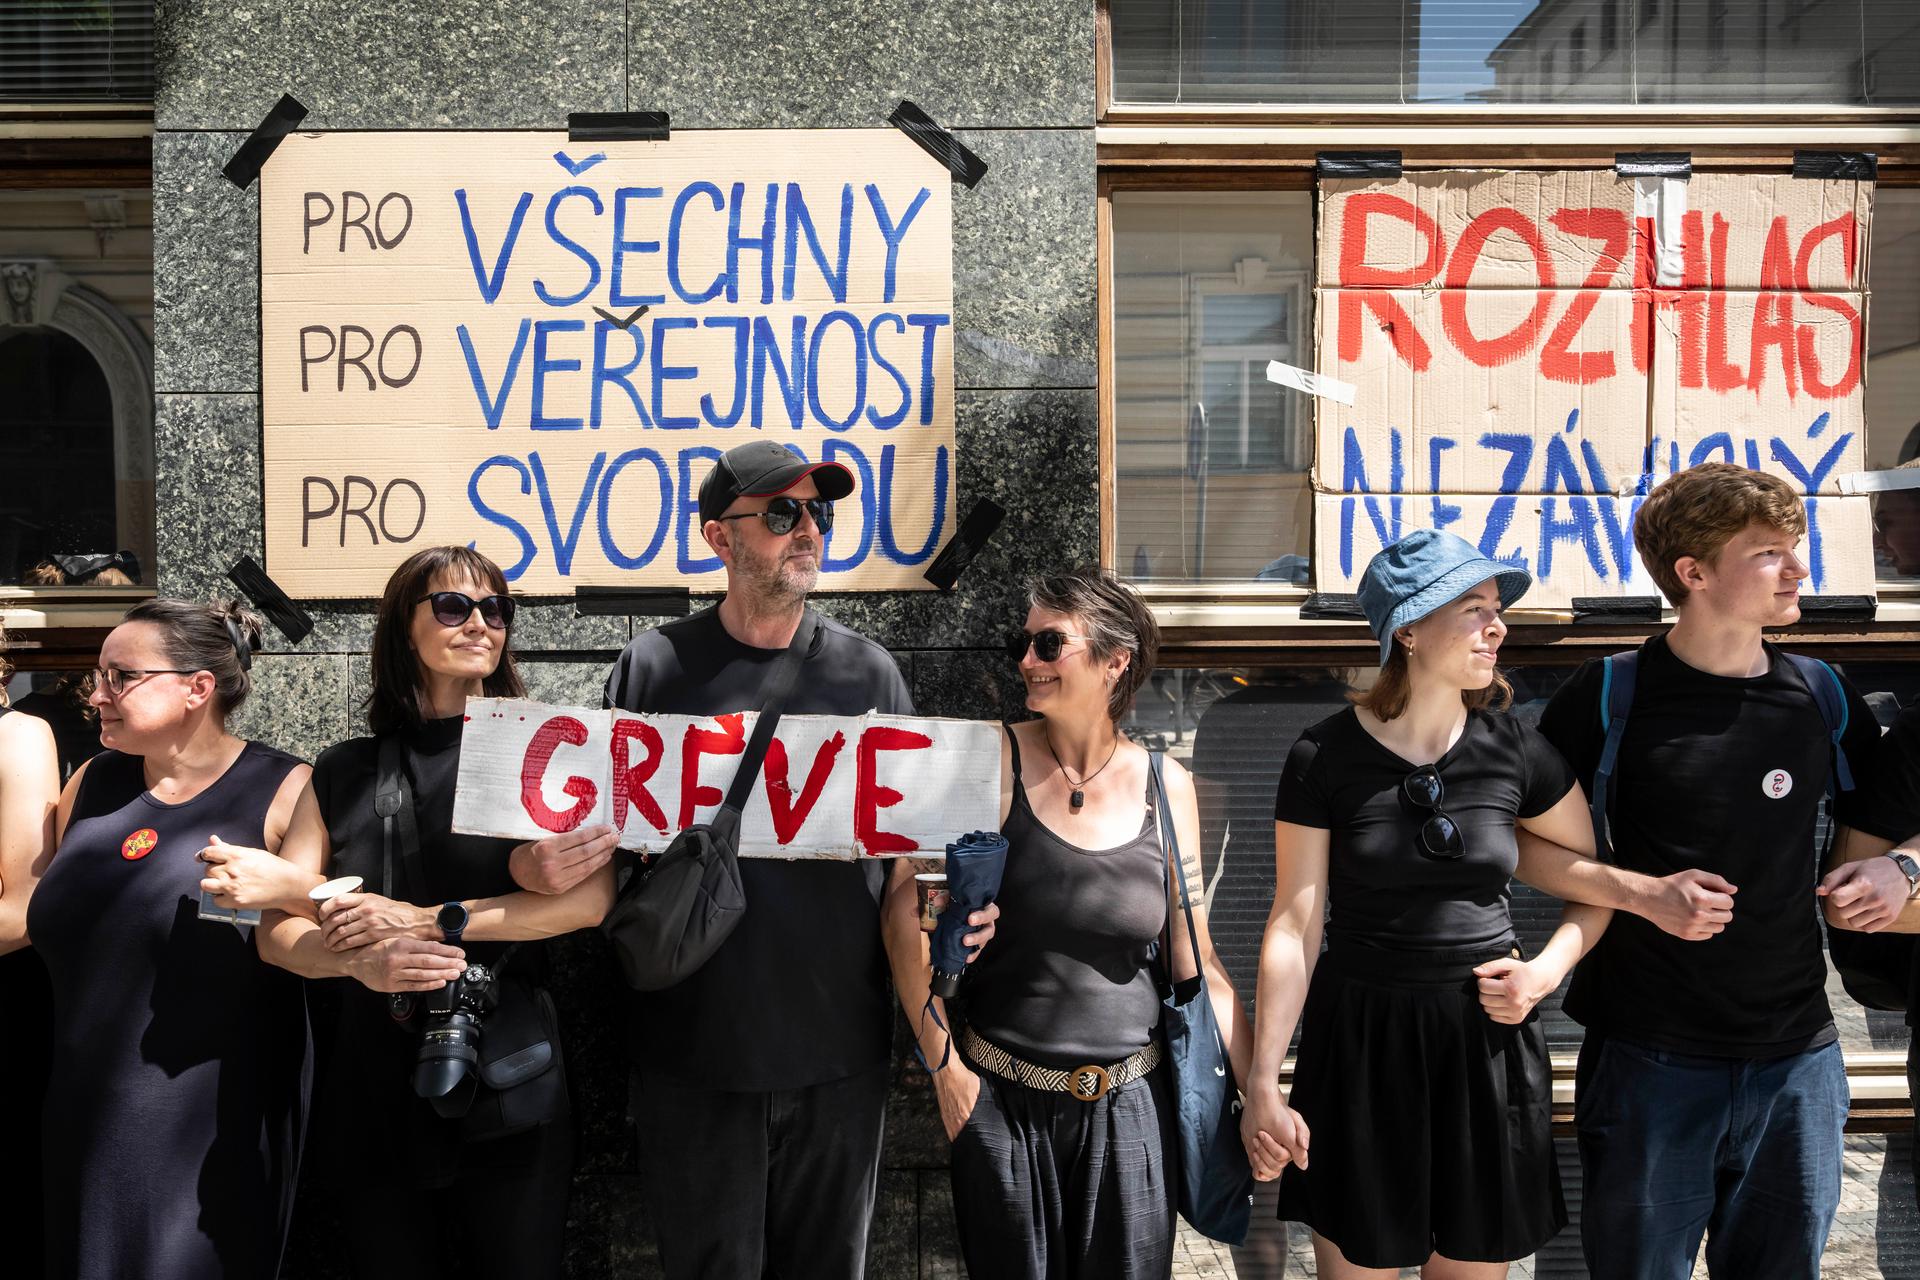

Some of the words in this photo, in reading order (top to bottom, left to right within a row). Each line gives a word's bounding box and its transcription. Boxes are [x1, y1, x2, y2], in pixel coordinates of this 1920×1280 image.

[303, 191, 413, 255] PRO
[454, 151, 931, 305] VŠECHNY
[1337, 192, 1863, 400] ROZHLAS
[300, 324, 422, 392] PRO
[456, 305, 951, 431] VEŘEJNOST
[302, 475, 426, 547] PRO
